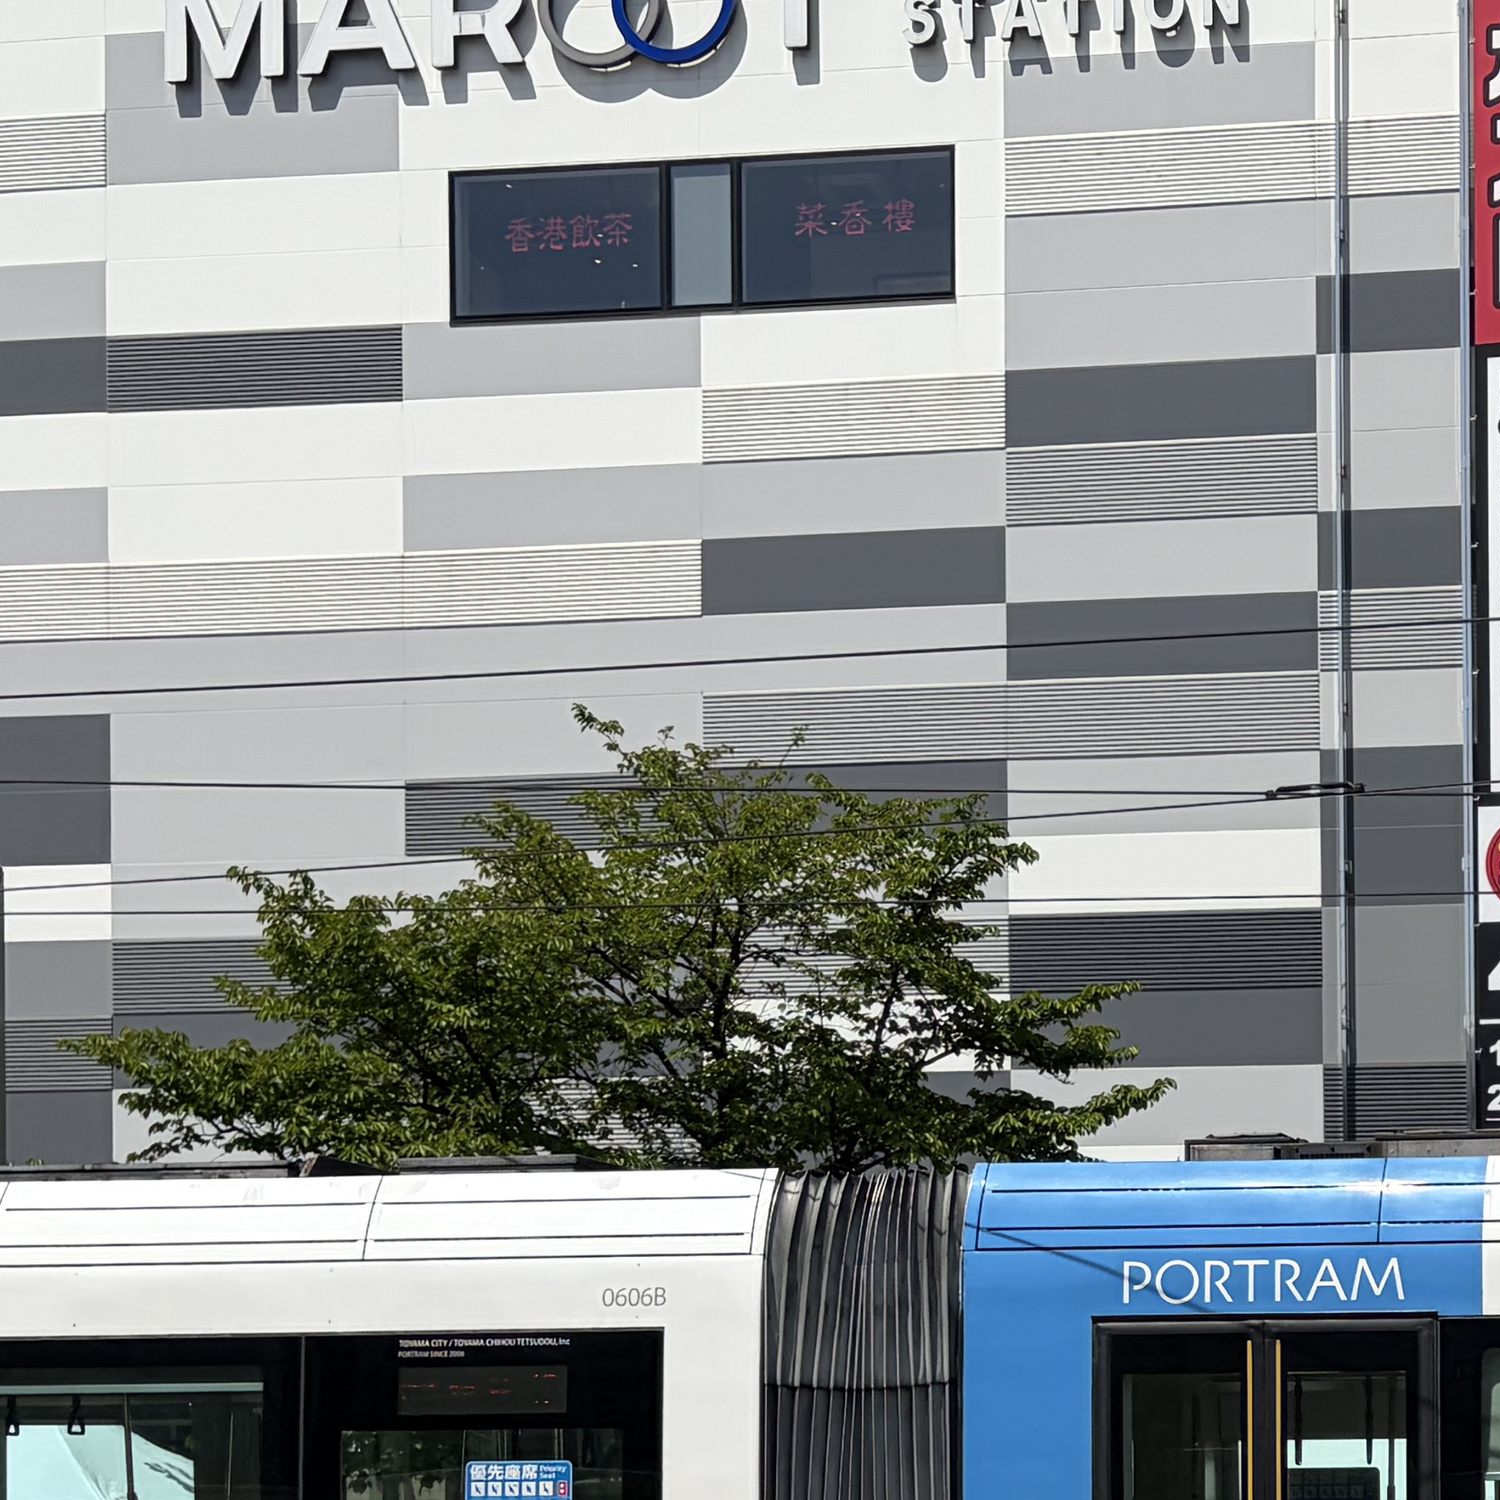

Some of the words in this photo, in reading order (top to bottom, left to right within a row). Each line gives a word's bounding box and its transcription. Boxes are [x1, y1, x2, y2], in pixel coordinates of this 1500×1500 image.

[504, 212, 633, 253] 香港飲茶
[1123, 1257, 1405, 1304] PORTRAM
[602, 1287, 667, 1307] 0606B
[470, 1464, 538, 1480] 優先座席
